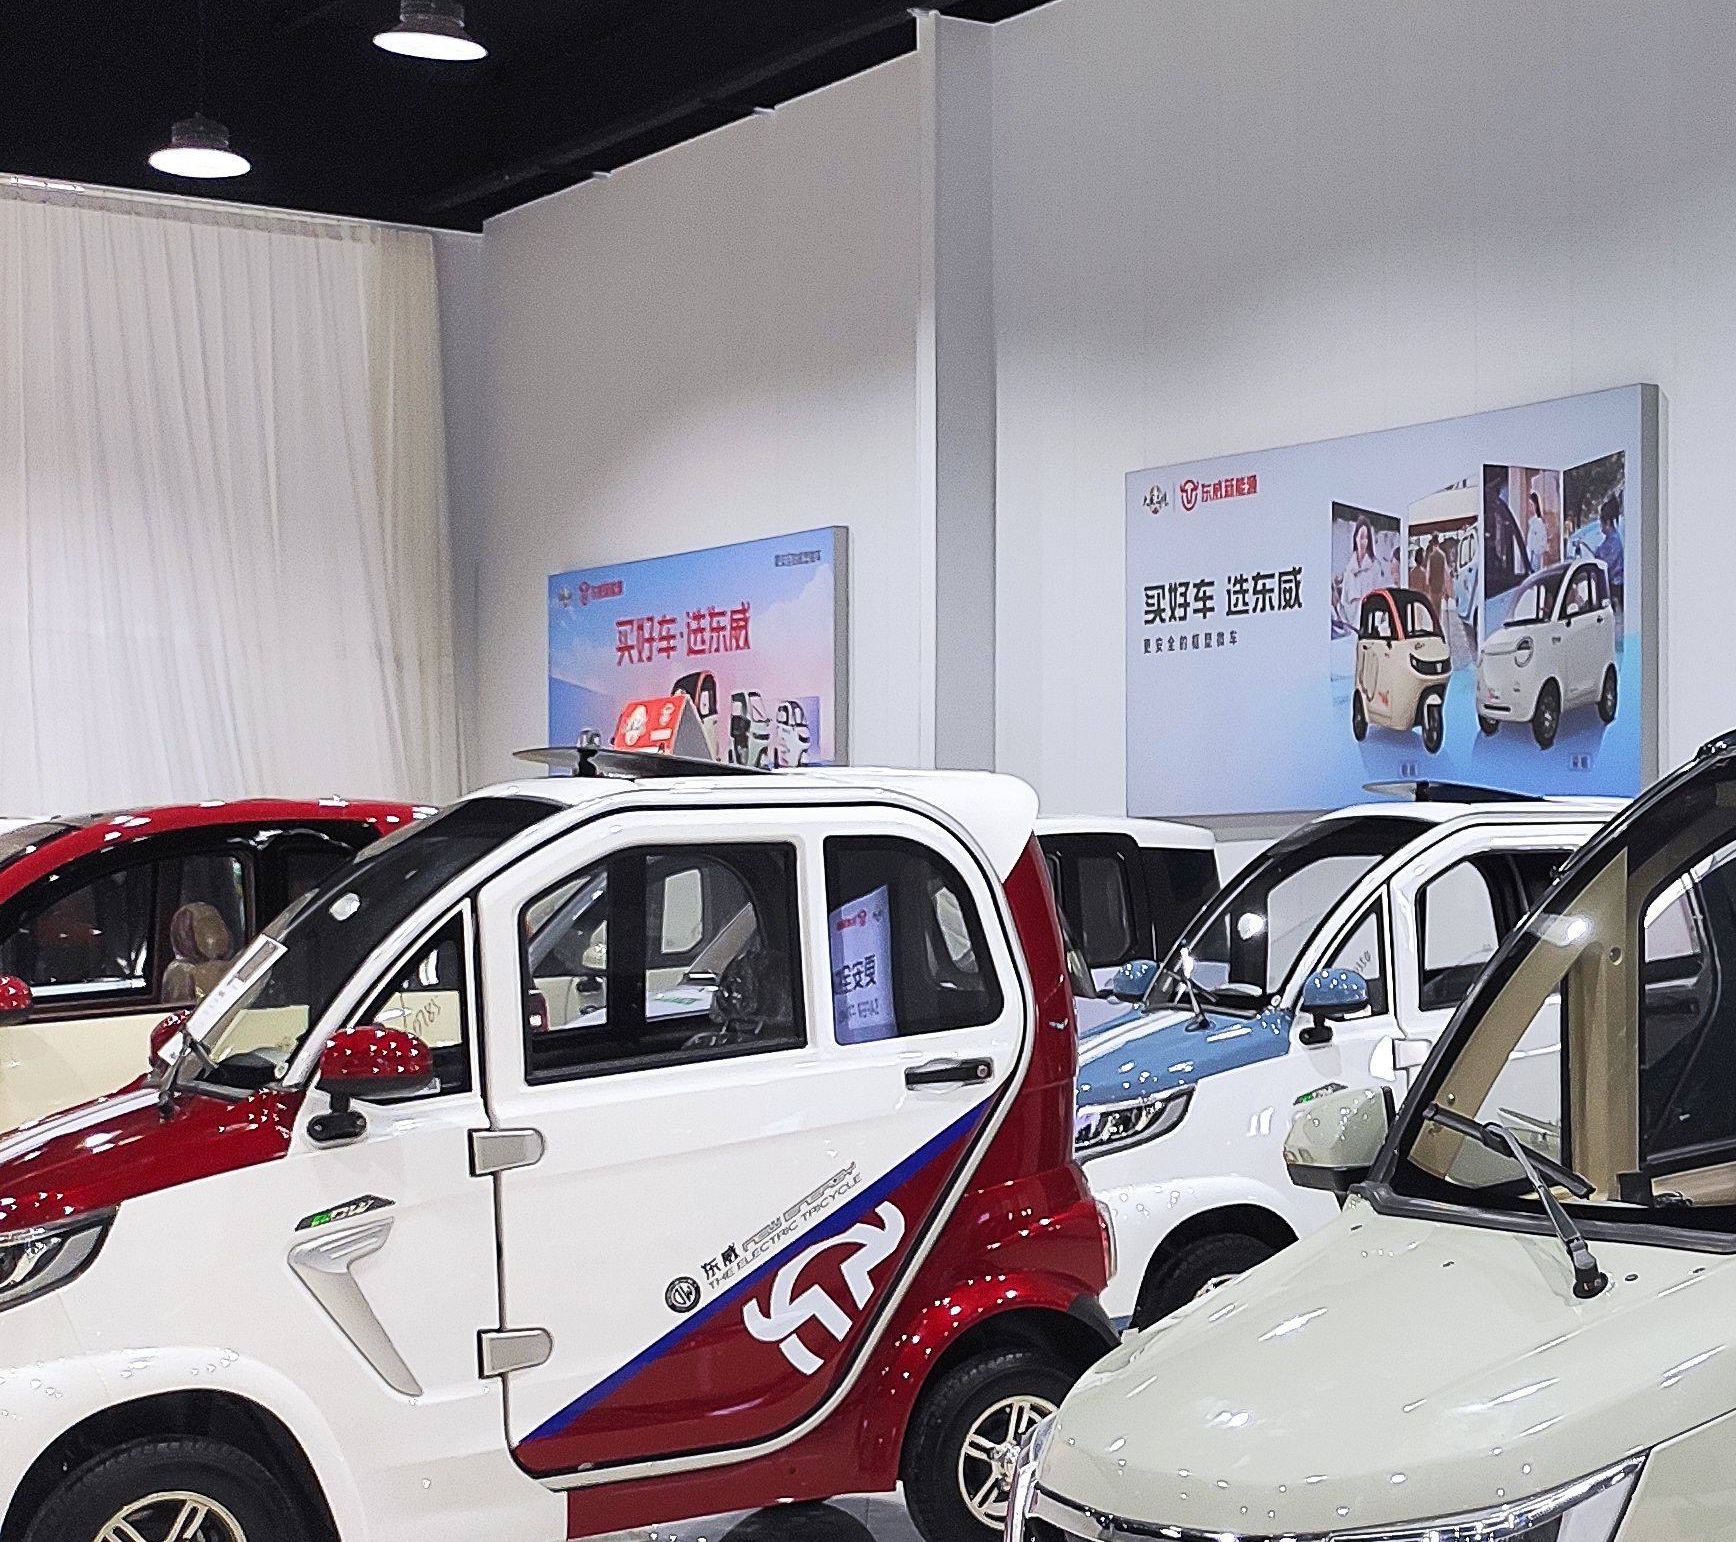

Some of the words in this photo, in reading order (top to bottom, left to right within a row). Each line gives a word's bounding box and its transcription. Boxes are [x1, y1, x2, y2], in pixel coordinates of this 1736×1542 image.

[1144, 579, 1215, 625] 买好车
[1226, 566, 1302, 616] 选东威
[708, 1269, 735, 1290] THE
[737, 1219, 799, 1271] ELECTRIC
[801, 1172, 863, 1222] TRICYCLE
[701, 1242, 740, 1280] 东威
